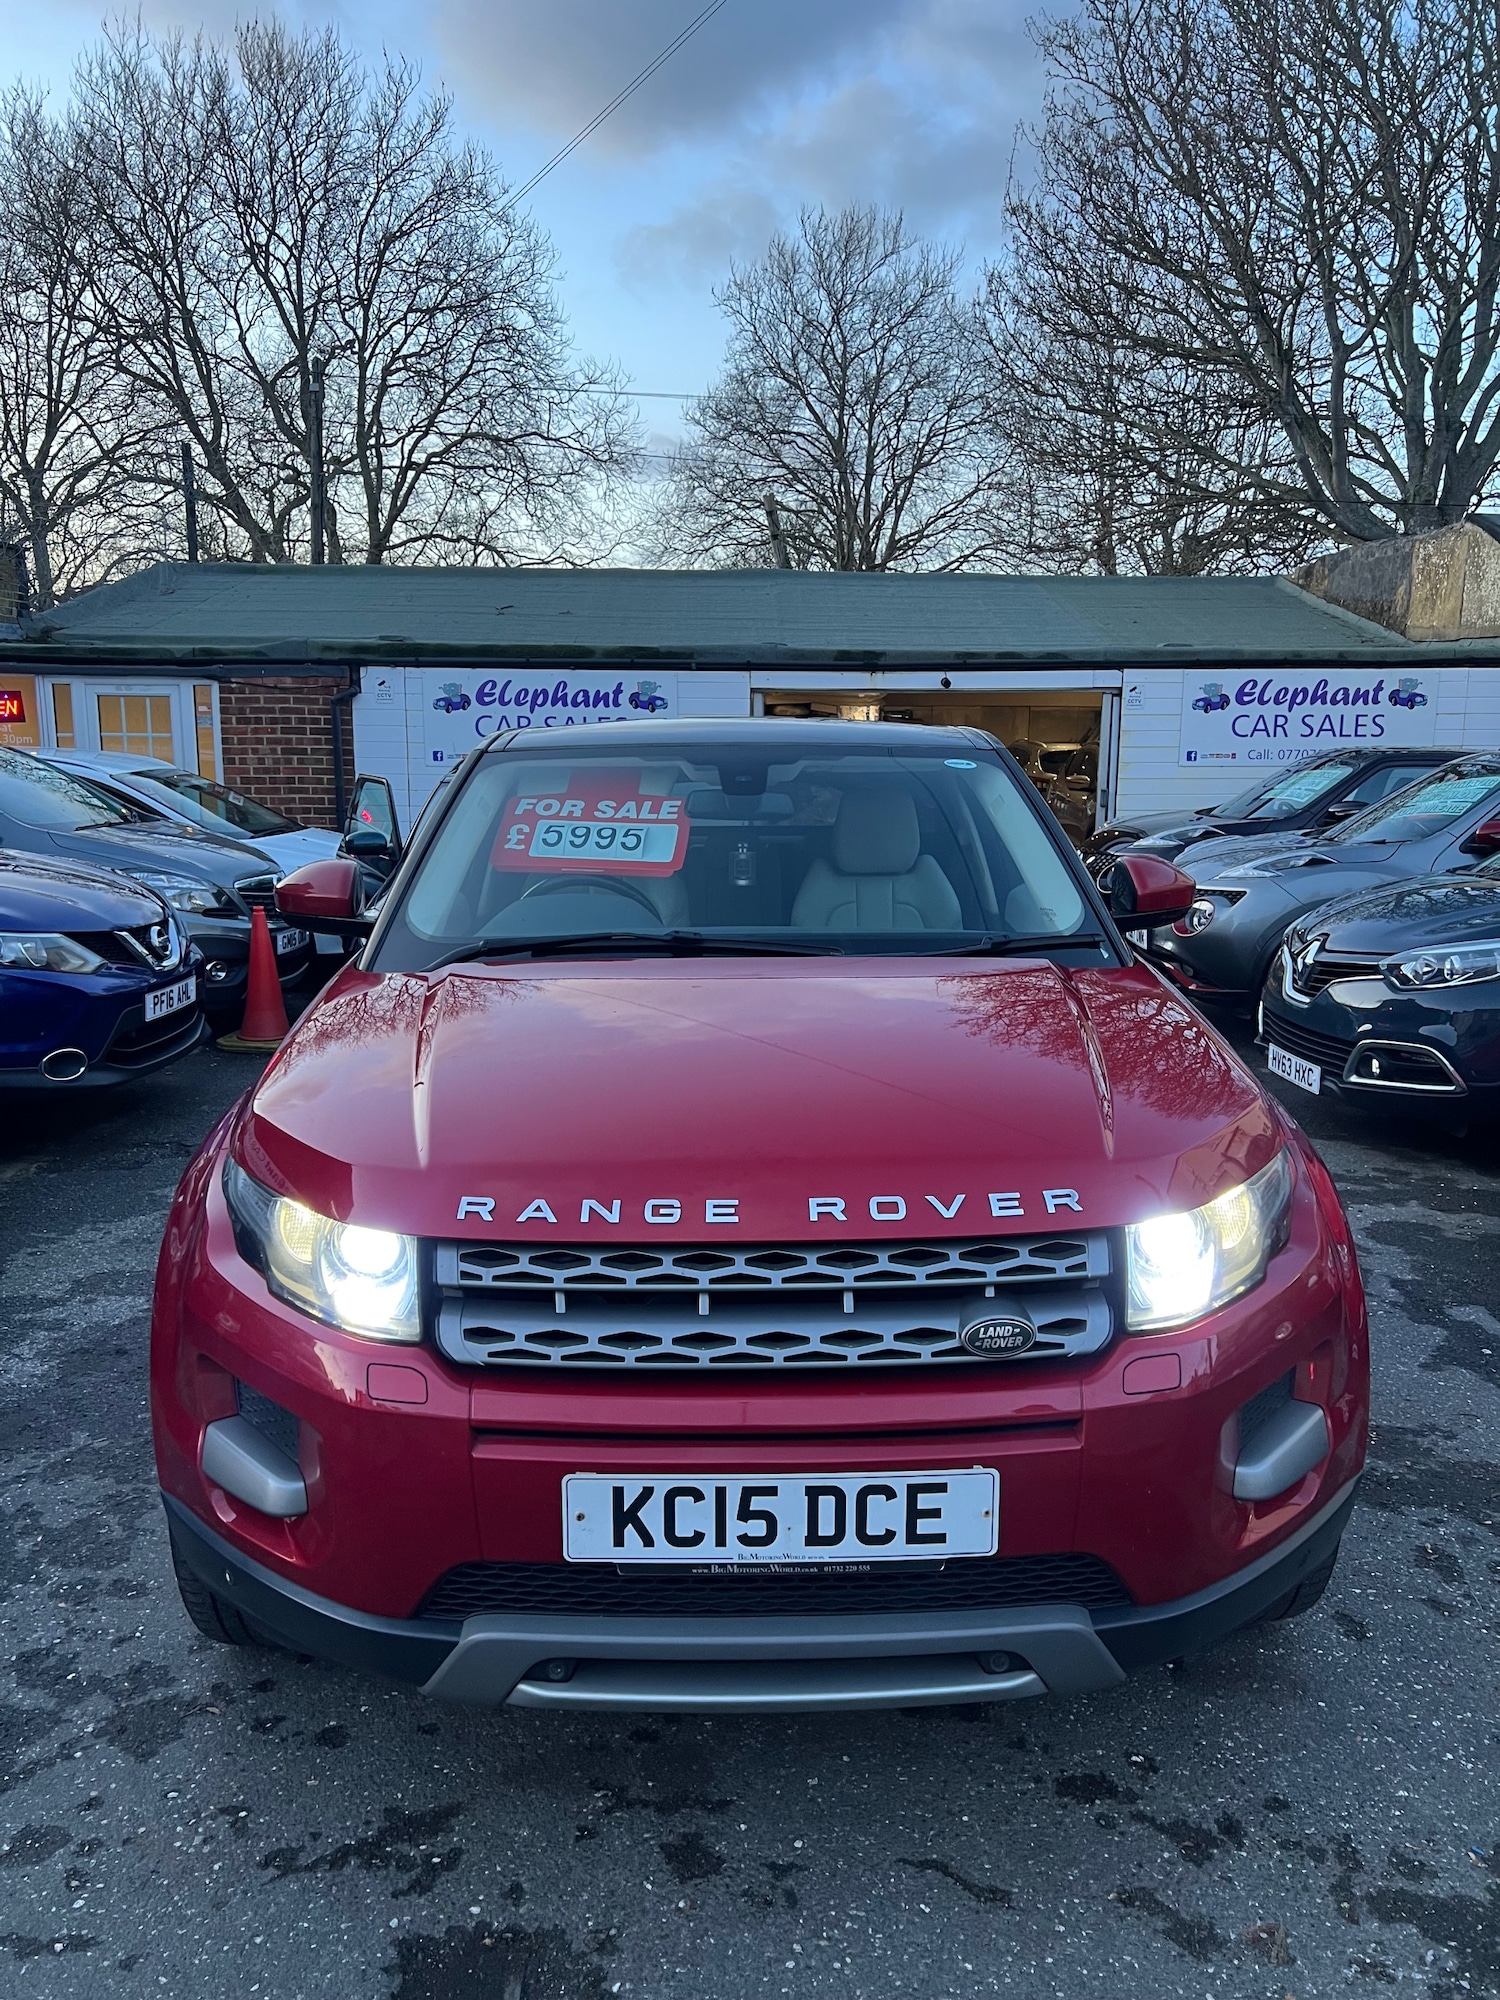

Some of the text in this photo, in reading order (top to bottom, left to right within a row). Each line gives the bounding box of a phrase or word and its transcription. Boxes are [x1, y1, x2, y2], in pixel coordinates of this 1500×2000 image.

[475, 679, 624, 714] Elephant
[1234, 678, 1385, 713] Elephant
[1231, 714, 1385, 738] CAR SALES
[1247, 749, 1273, 760] Call:
[514, 799, 682, 819] FOR SALE
[504, 824, 644, 851] £ 5995
[153, 982, 191, 1015] PF16 AHL
[1294, 1060, 1314, 1087] HXC
[457, 1188, 1084, 1224] RANGE ROVER
[979, 1326, 1013, 1338] LAND
[982, 1336, 1023, 1349] ROVER
[612, 1482, 948, 1548] KC15 DCE
